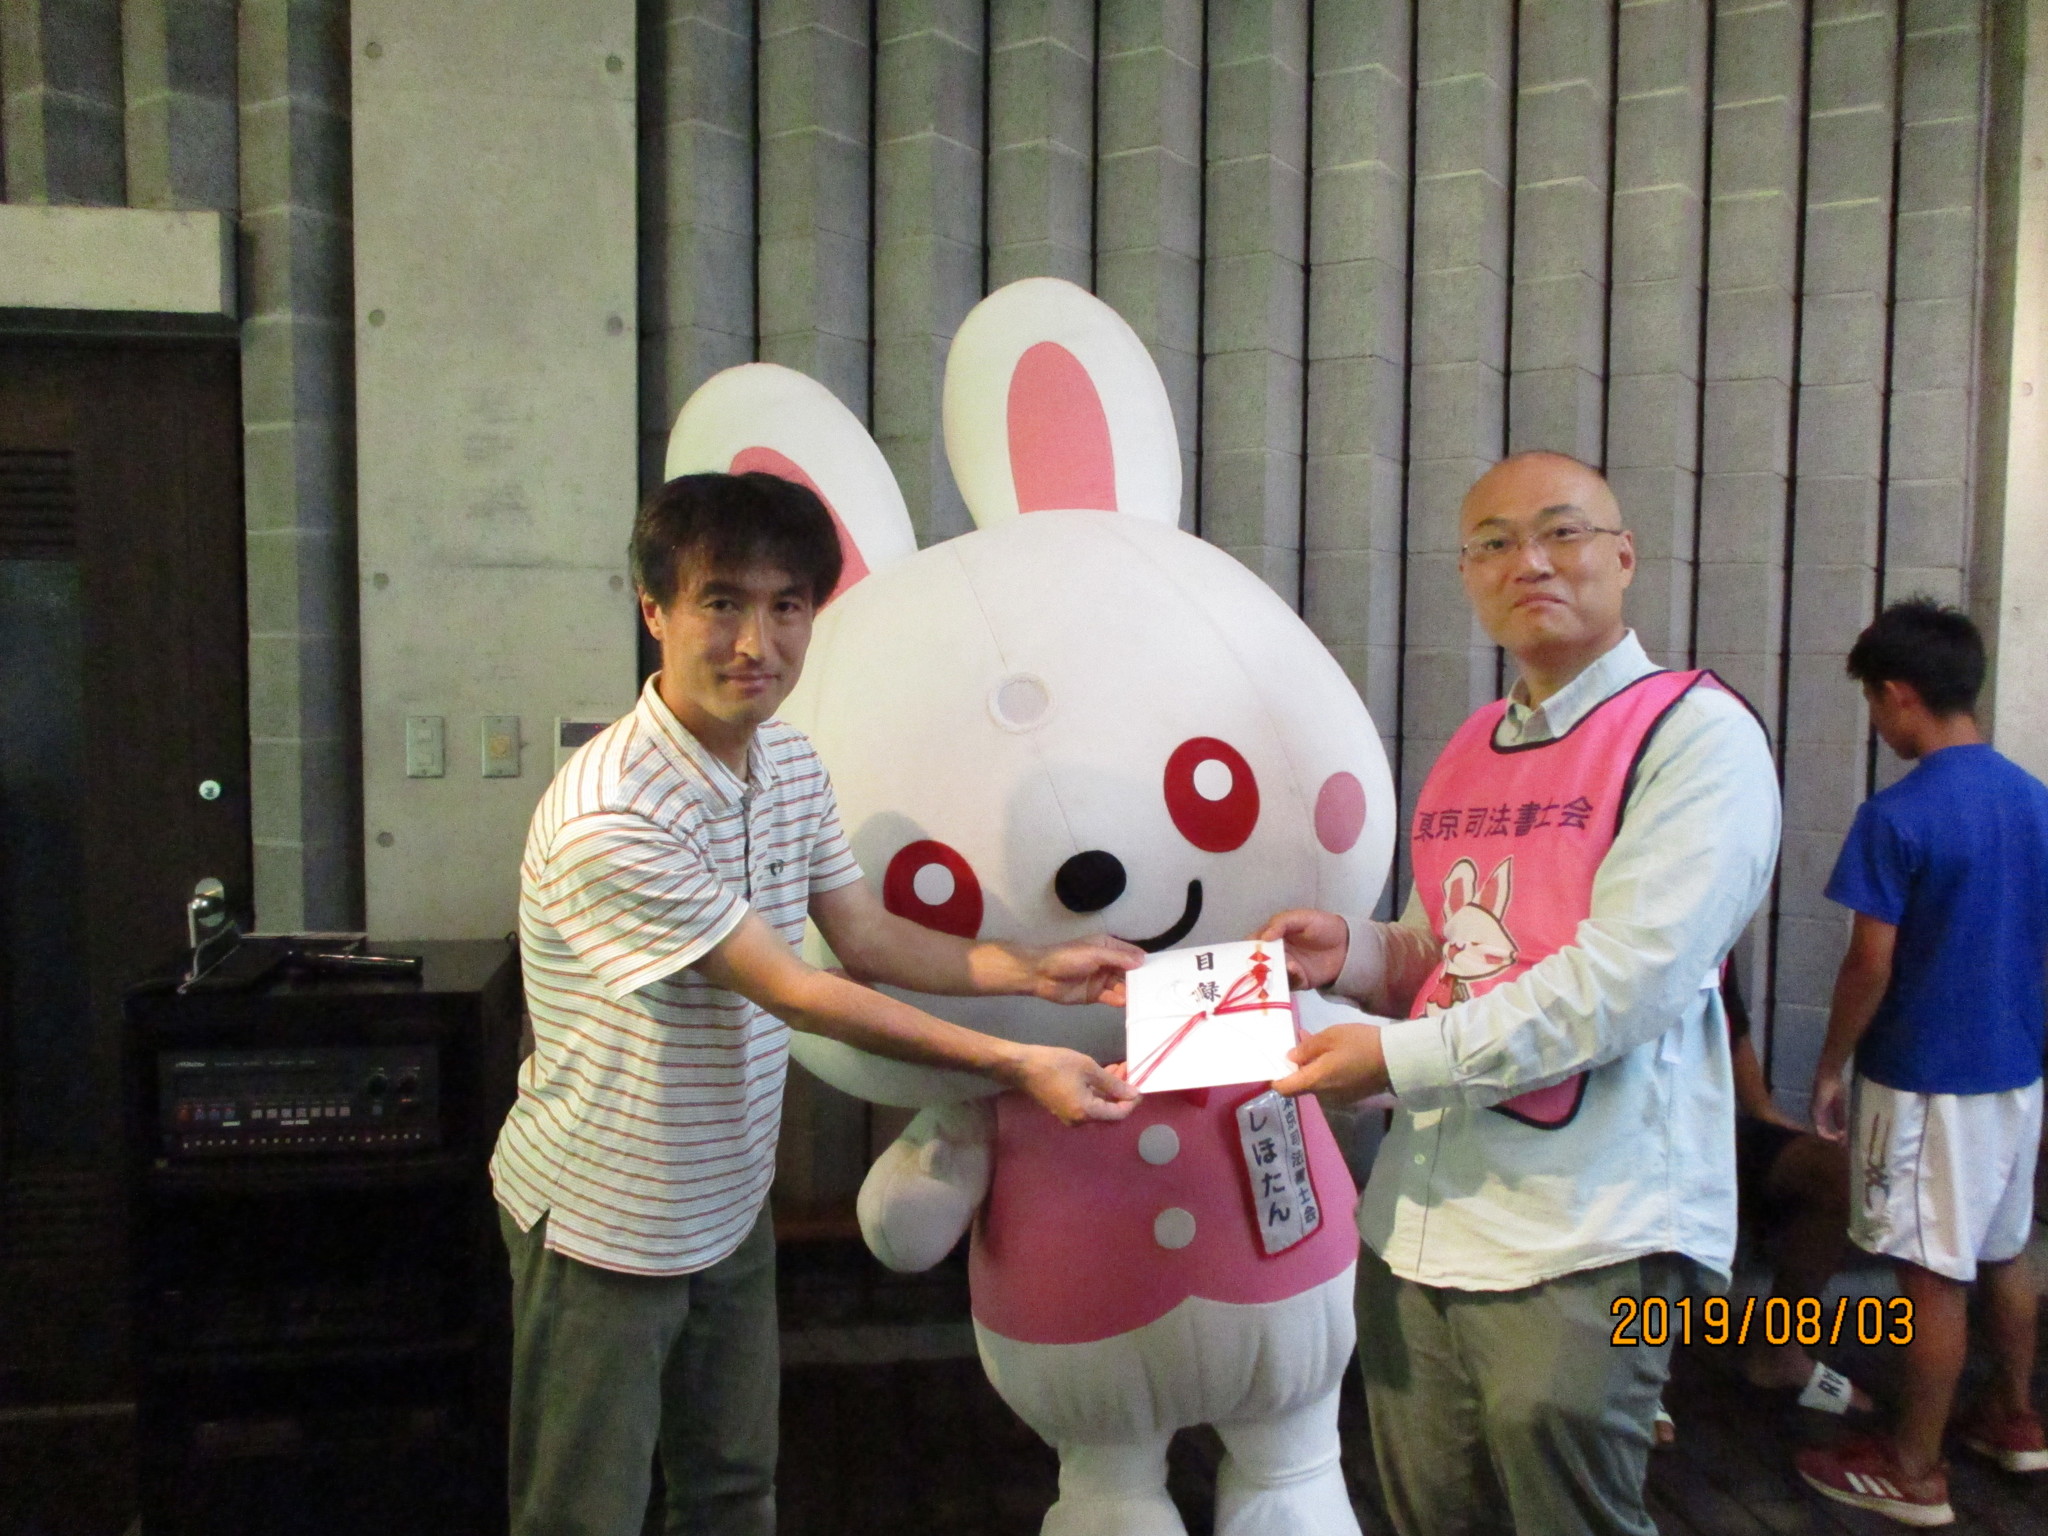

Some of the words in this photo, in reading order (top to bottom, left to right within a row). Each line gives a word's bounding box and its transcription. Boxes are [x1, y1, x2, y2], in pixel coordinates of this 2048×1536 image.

[1413, 796, 1593, 842] 東京司法書士会
[1194, 951, 1221, 1003] 目録
[1249, 1110, 1290, 1228] しほたん
